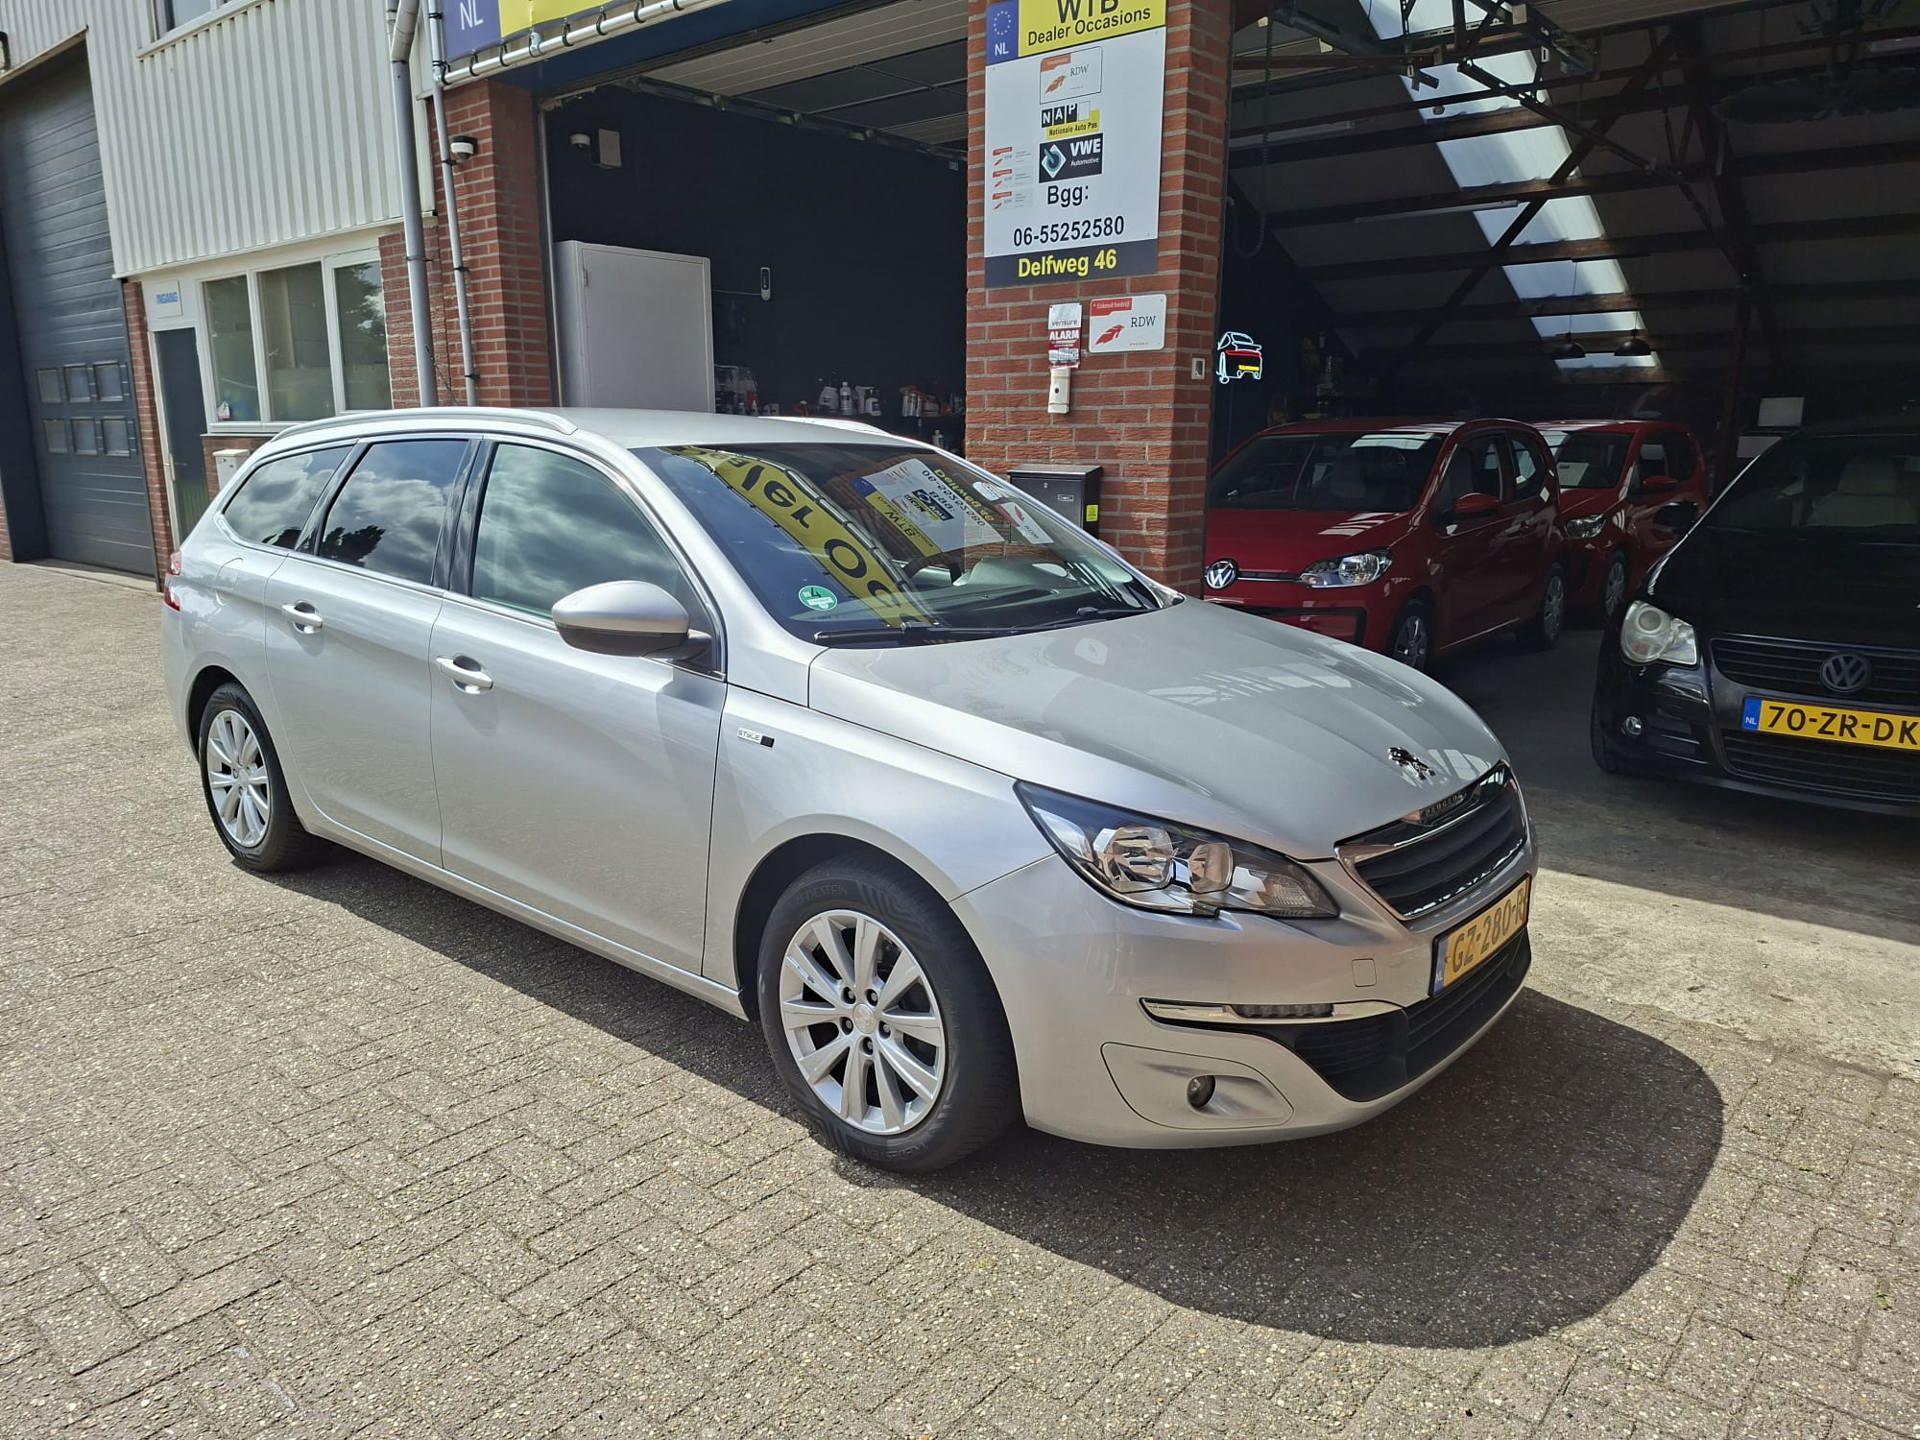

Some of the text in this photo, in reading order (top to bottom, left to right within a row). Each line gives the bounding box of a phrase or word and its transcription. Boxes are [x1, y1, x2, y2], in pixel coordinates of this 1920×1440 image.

[460, 0, 484, 30] NL
[1028, 7, 1151, 46] Dealer Occasions
[995, 43, 1009, 56] NL
[1070, 64, 1090, 77] RDW
[1042, 103, 1077, 126] NAP
[1049, 121, 1098, 136] Nationale Auto Pas
[1070, 138, 1101, 156] VWE
[1071, 157, 1099, 167] Automotive
[1047, 184, 1090, 208] Bgg:
[1013, 215, 1125, 247] 06-55252580
[1018, 249, 1117, 278] Delfweg 46
[1131, 315, 1157, 328] RDW
[1049, 329, 1080, 341] ALARM
[1745, 706, 1919, 746] NL 70-ZR-DK
